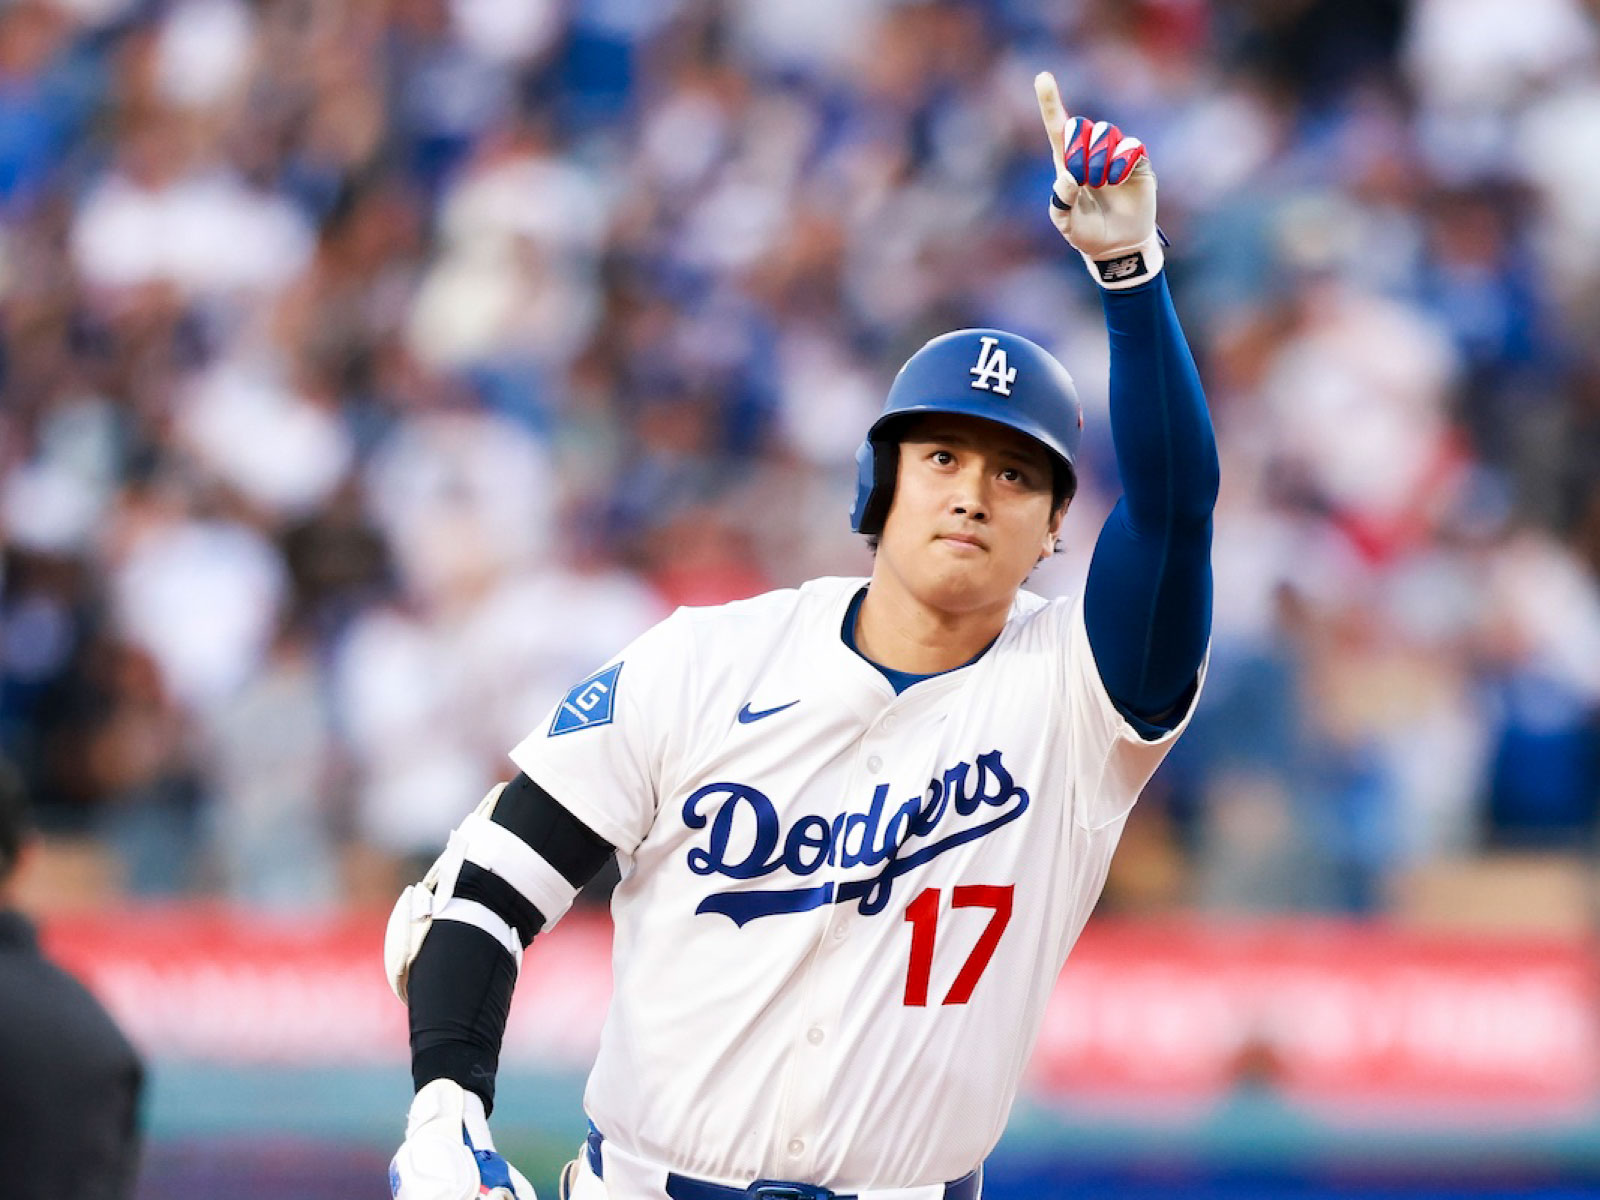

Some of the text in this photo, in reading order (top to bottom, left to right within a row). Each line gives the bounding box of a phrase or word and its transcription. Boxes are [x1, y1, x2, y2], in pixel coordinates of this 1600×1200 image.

[970, 336, 1018, 396] LA
[682, 750, 1030, 928] Dodgers
[903, 884, 1015, 1007] 17
